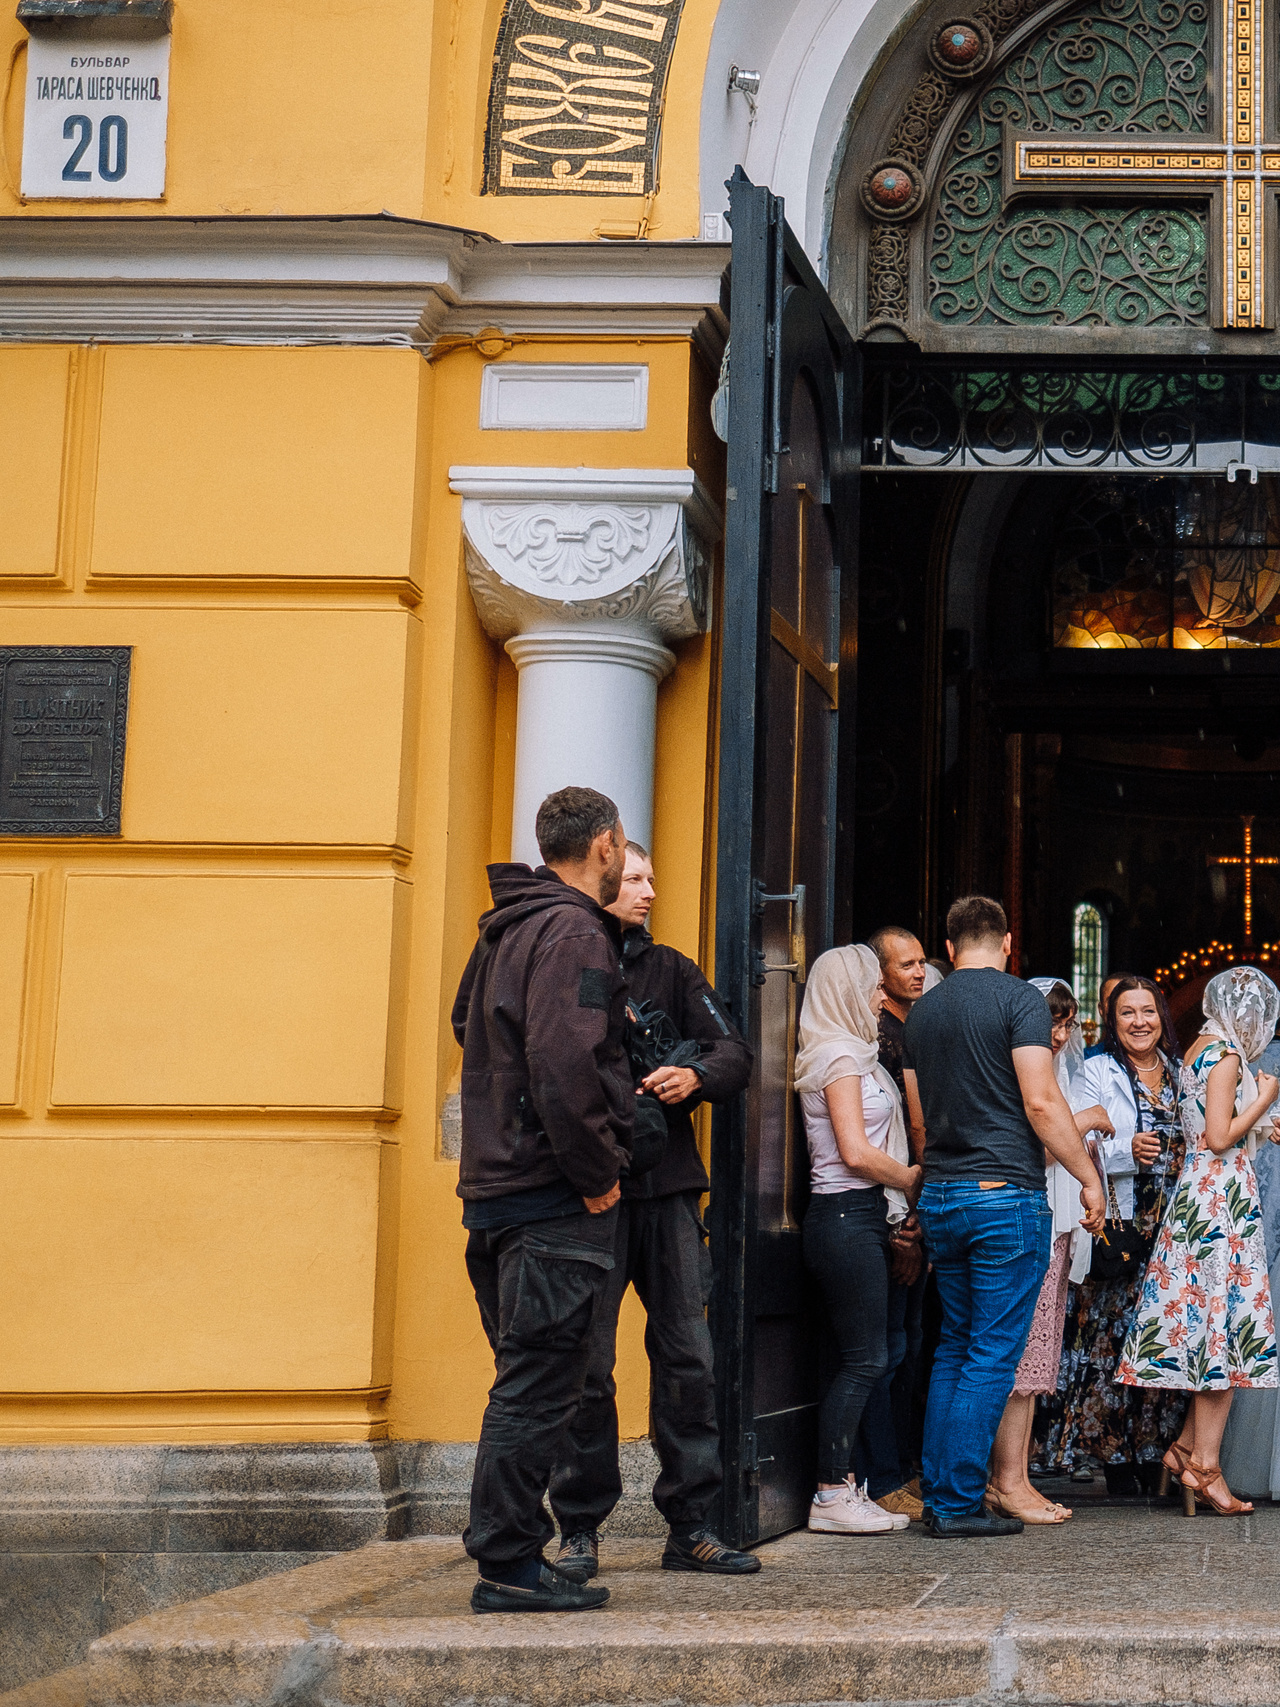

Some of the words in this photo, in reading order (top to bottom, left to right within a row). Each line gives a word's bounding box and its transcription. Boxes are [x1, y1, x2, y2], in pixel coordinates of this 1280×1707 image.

[70, 57, 131, 68] БУЛЬВАР
[37, 77, 84, 100] ТАРАСА
[88, 77, 160, 101] ШЕВЧЕНКО
[62, 114, 128, 182] 20
